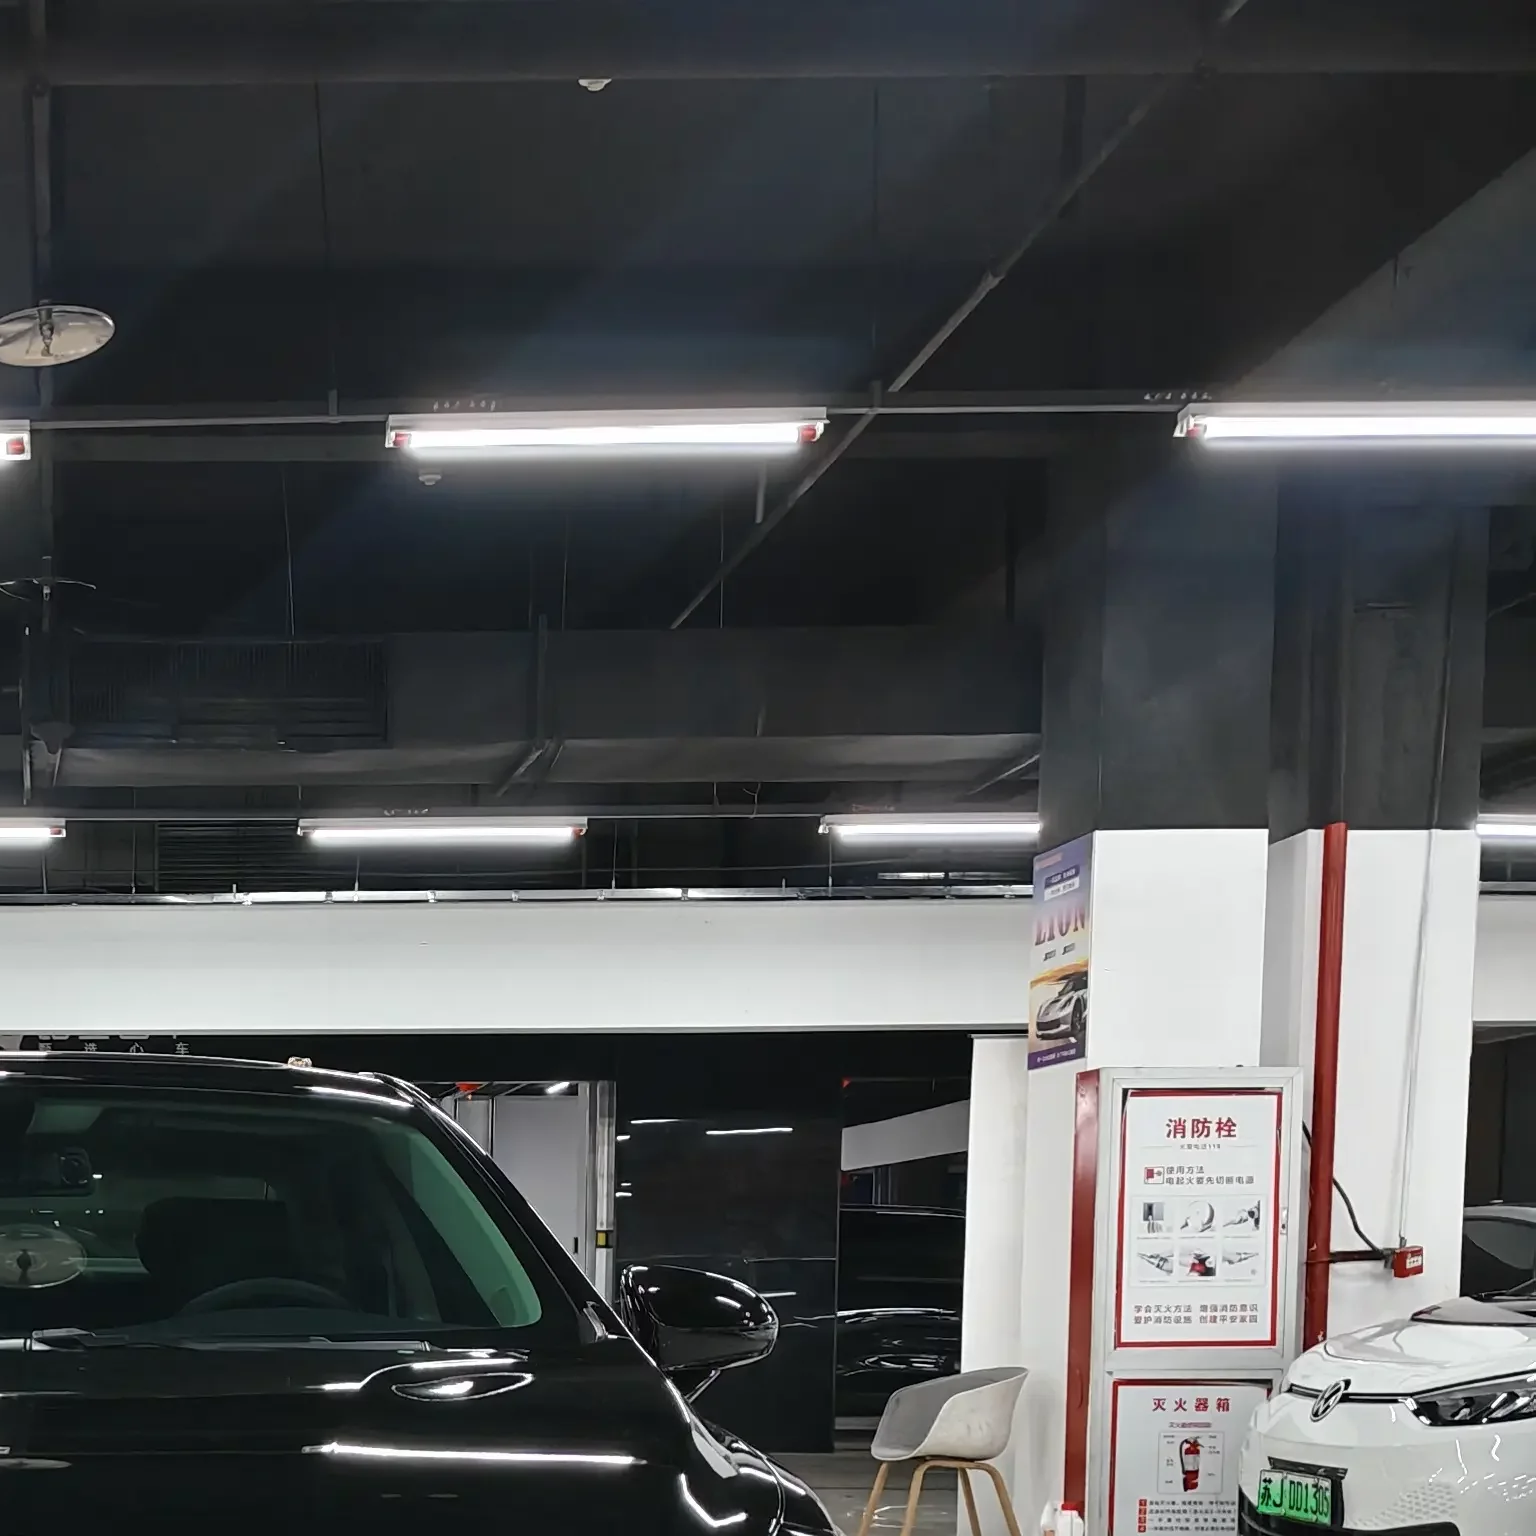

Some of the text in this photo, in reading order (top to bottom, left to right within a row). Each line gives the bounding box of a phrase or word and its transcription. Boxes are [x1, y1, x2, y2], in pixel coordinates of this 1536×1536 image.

[1166, 1117, 1237, 1139] 消防栓
[1166, 1166, 1205, 1175] 使用方法
[1134, 1303, 1258, 1313] 学会灭火方法 增强消防意识
[1134, 1314, 1258, 1324] 爱护消防设施 创建平安家园
[1152, 1398, 1230, 1412] 灭火器箱
